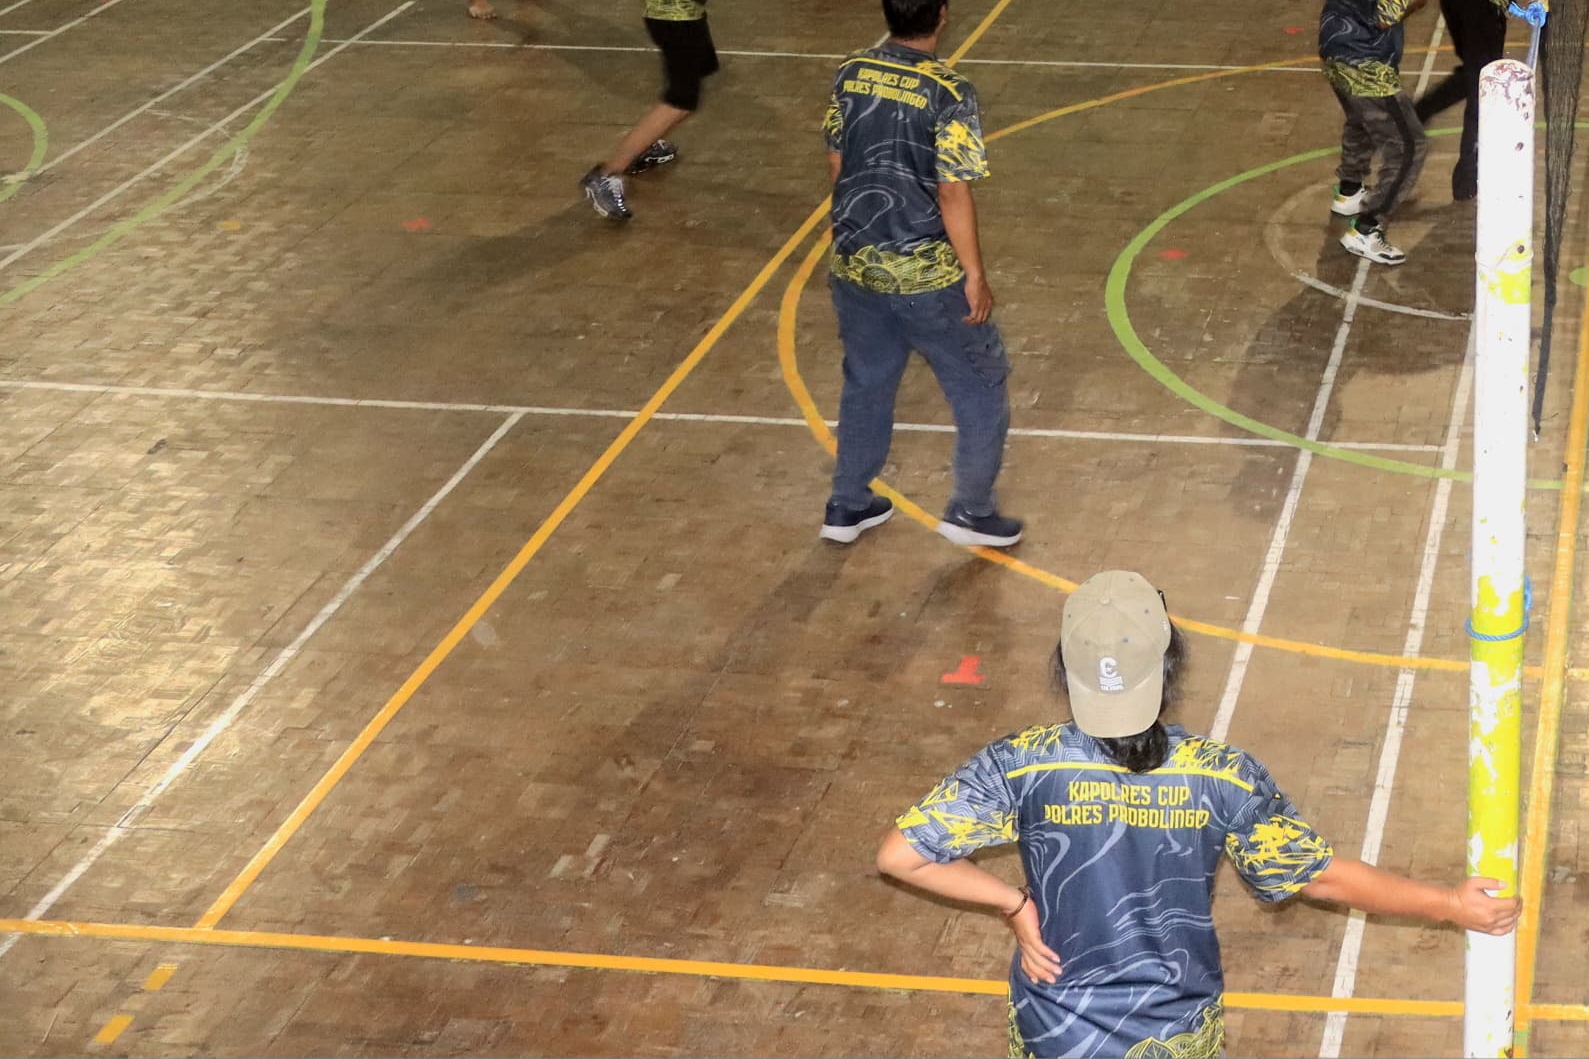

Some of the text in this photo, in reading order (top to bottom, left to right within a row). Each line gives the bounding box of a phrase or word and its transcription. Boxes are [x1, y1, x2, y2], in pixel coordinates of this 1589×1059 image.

[900, 75, 920, 90] CUP
[1068, 781, 1191, 806] KAPOLRES CUP
